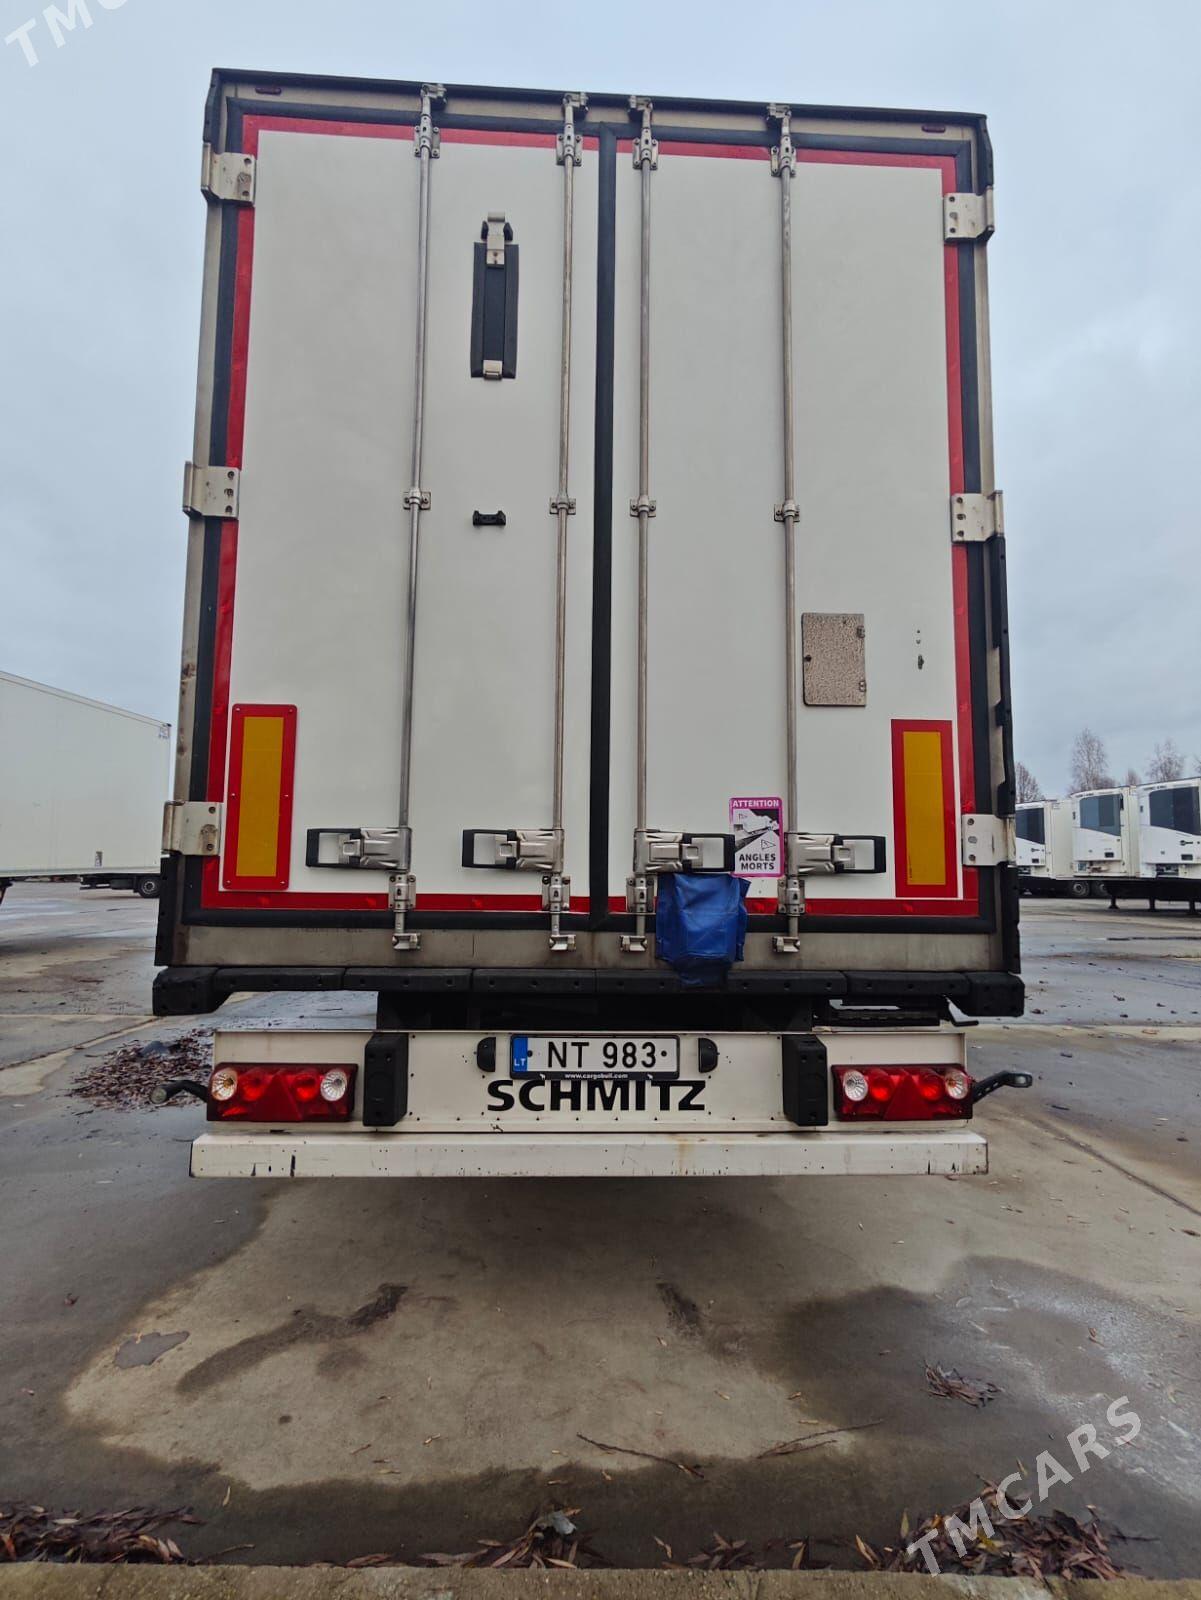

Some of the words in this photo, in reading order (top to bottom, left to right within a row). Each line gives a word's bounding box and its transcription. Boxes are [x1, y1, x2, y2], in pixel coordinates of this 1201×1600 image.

[732, 799, 779, 807] ATTENTION
[739, 853, 776, 862] ANGLES
[740, 862, 775, 871] MORTS
[547, 1041, 589, 1068] NT
[602, 1041, 656, 1068] 983
[514, 1058, 526, 1067] LT
[487, 1079, 706, 1111] SCHMITZ
